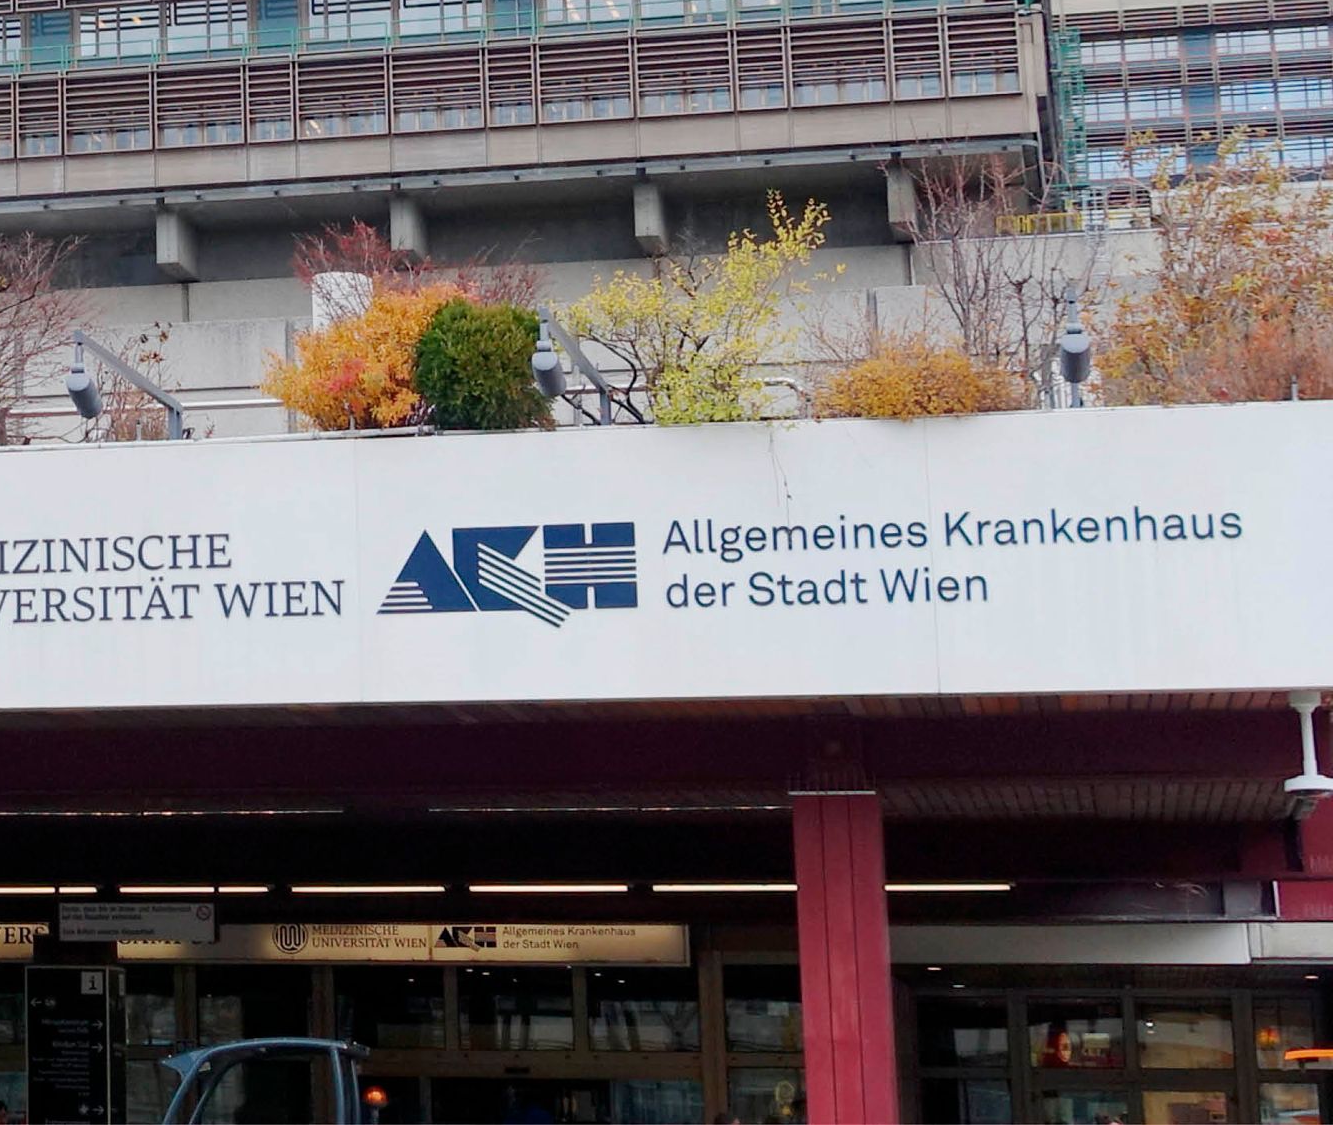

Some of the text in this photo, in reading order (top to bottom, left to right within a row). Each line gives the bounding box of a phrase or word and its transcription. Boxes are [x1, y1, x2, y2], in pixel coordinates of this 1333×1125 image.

[662, 507, 1243, 561] Allgemeines Krankenhaus
[666, 566, 989, 608] der Stadt Wien
[214, 580, 345, 618] WIEN
[312, 925, 399, 936] MEDIZINISCHE
[502, 926, 636, 937] Allgemeines Krankenhaus
[312, 936, 427, 948] UNIVERSITÄT WIEN
[503, 939, 579, 949] der Stadt Wien
